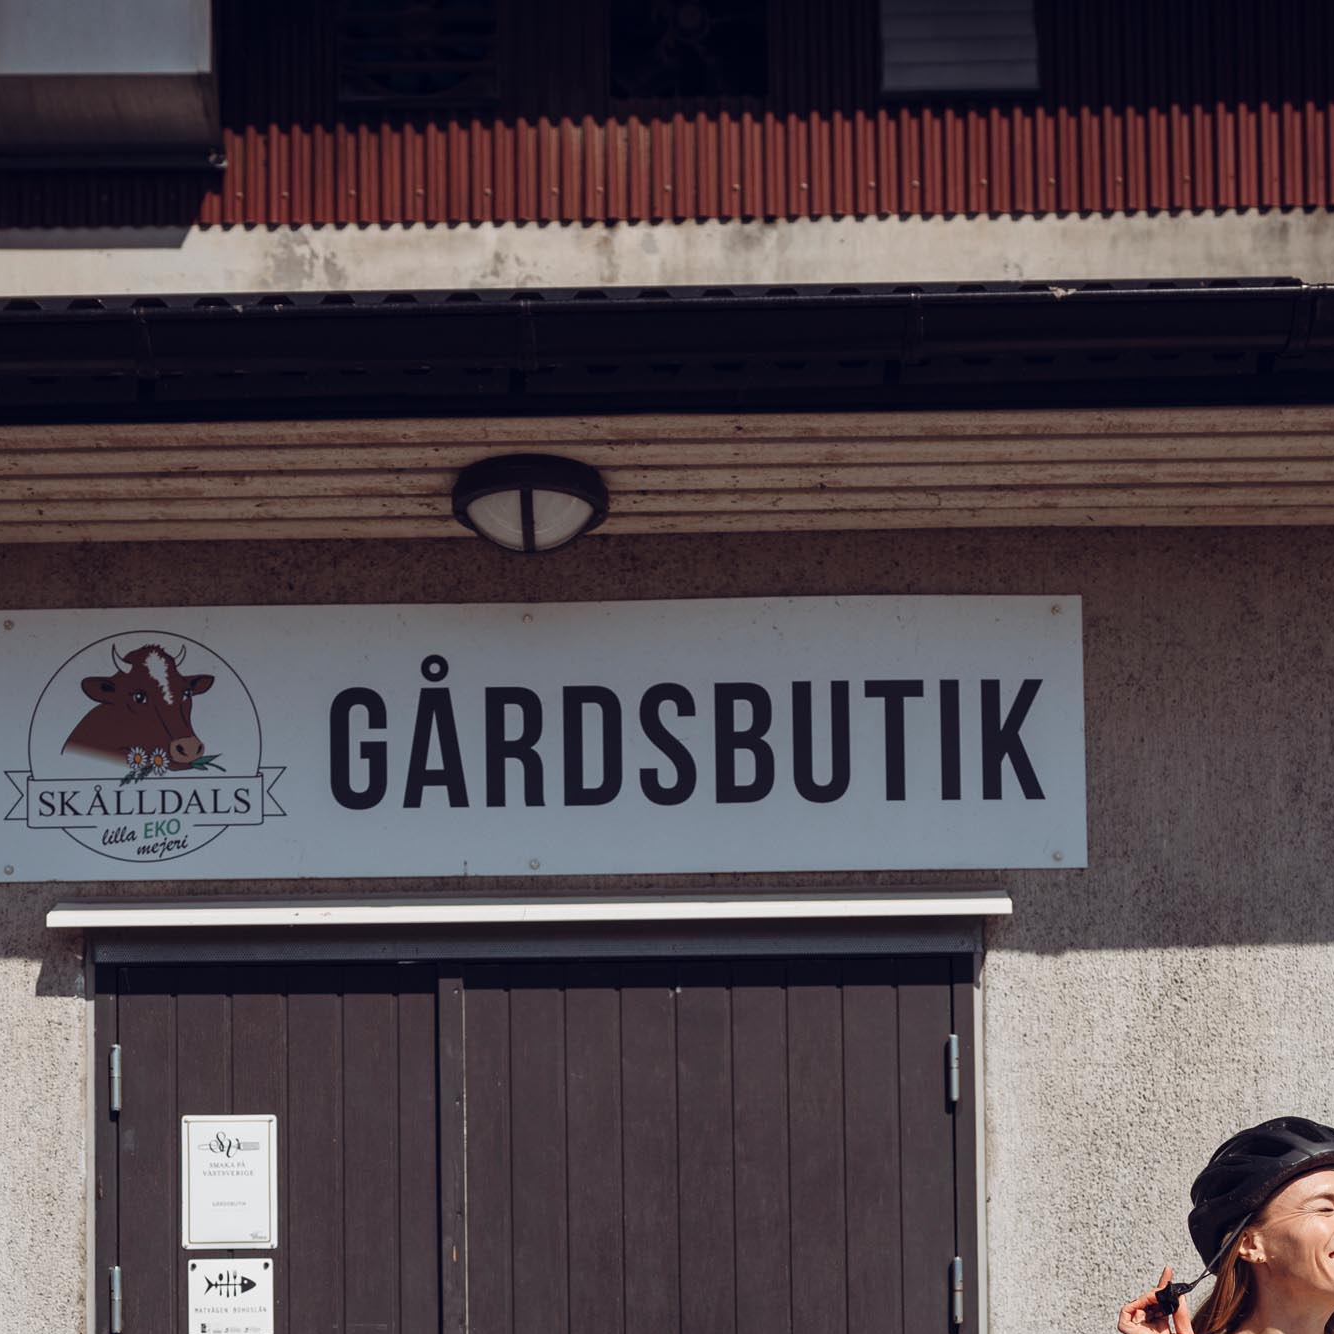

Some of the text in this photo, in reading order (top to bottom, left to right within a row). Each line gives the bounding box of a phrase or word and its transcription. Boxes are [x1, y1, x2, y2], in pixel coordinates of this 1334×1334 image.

[330, 654, 1046, 811] GÅRDSBUTIK
[38, 785, 252, 817] SKÅLLDALS
[102, 818, 182, 846] lilla EKO
[136, 835, 189, 858] mejeri
